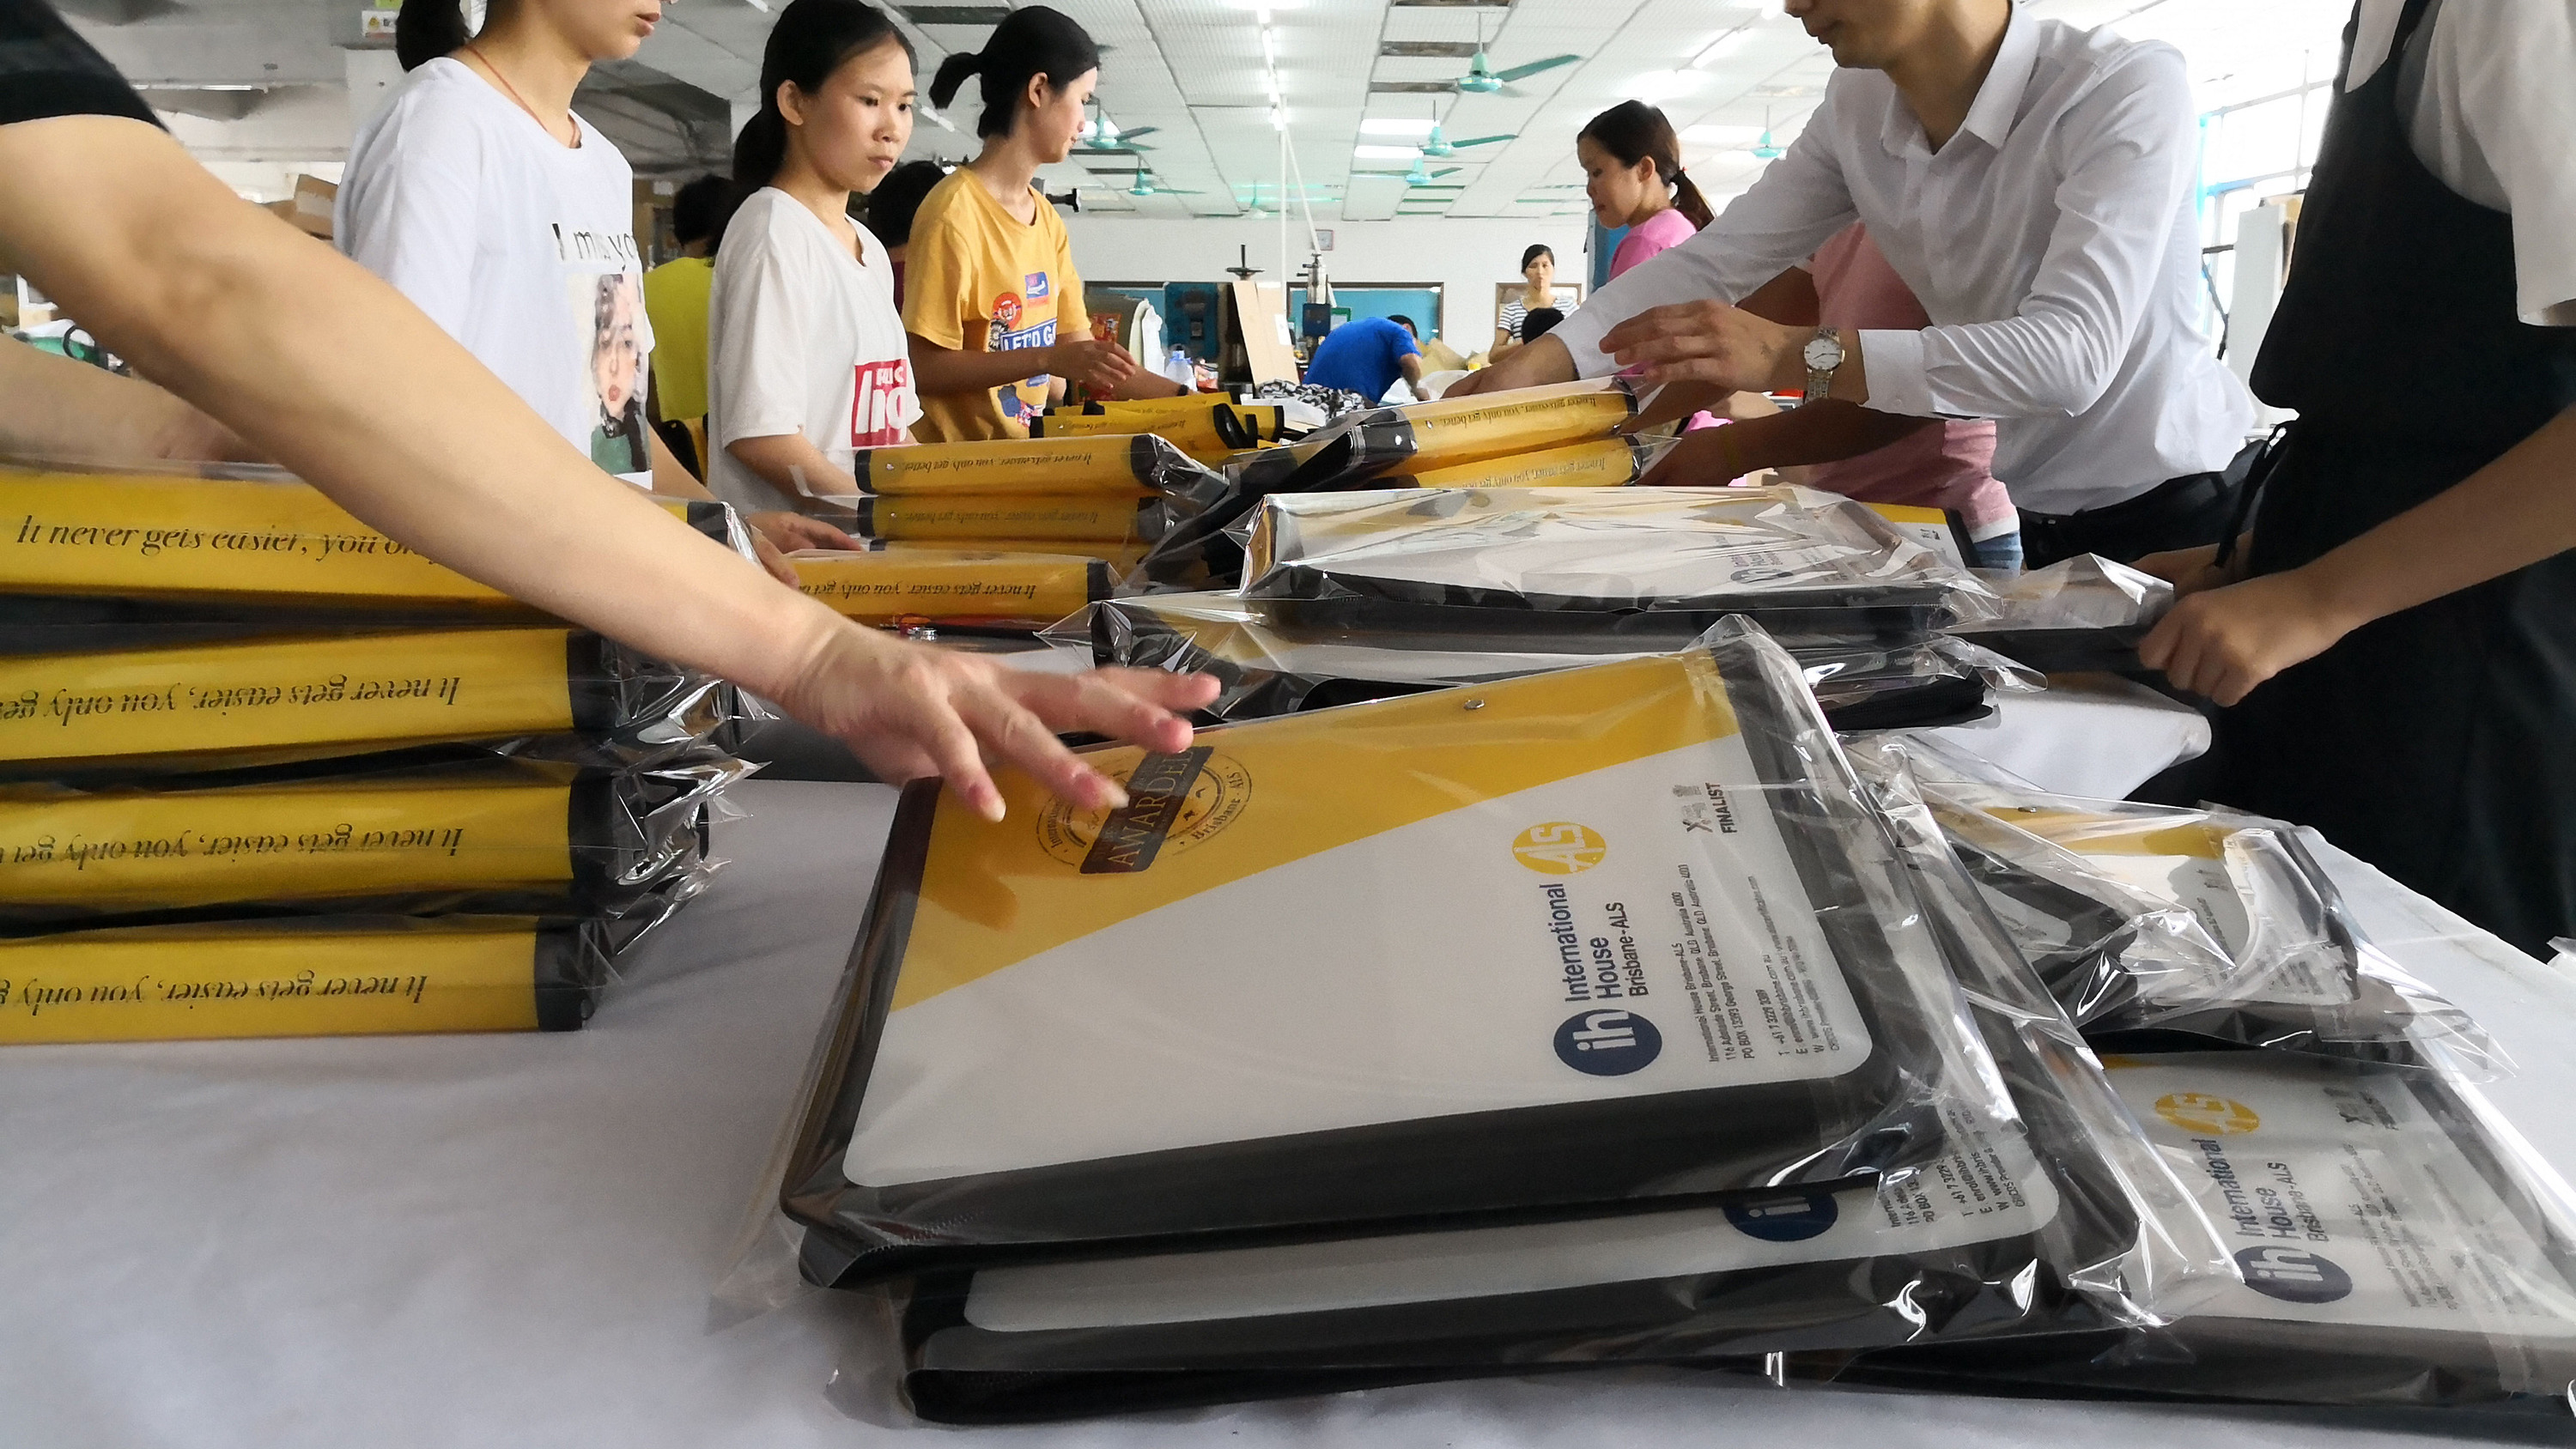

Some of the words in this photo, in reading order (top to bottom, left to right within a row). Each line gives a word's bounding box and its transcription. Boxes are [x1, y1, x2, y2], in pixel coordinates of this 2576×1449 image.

[17, 514, 43, 543] It
[49, 525, 139, 546] never
[141, 528, 204, 556] gets
[315, 532, 379, 562] you
[841, 581, 872, 599] only
[873, 583, 902, 595] you
[954, 582, 981, 596] gets
[982, 585, 1024, 597] never
[120, 681, 181, 713] you
[289, 673, 348, 706] gets
[350, 678, 432, 701] never
[439, 676, 461, 706] It
[44, 687, 114, 727] only
[1704, 782, 1738, 834] FINALIST
[65, 833, 128, 871] only
[133, 829, 192, 860] you
[362, 828, 435, 852] never
[1539, 882, 1592, 1003] International
[1606, 901, 1649, 997] Brisbane-ALS
[1589, 936, 1623, 1000] House
[21, 977, 83, 1016] only
[89, 974, 150, 1003] you
[256, 969, 315, 1002] gets
[316, 975, 400, 997] never
[405, 974, 429, 1004] It
[1572, 1010, 1637, 1052] ih
[1736, 1029, 1751, 1046] BOX
[1741, 1047, 1755, 1059] PO
[2190, 1137, 2265, 1237] International
[2255, 1186, 2301, 1240] House
